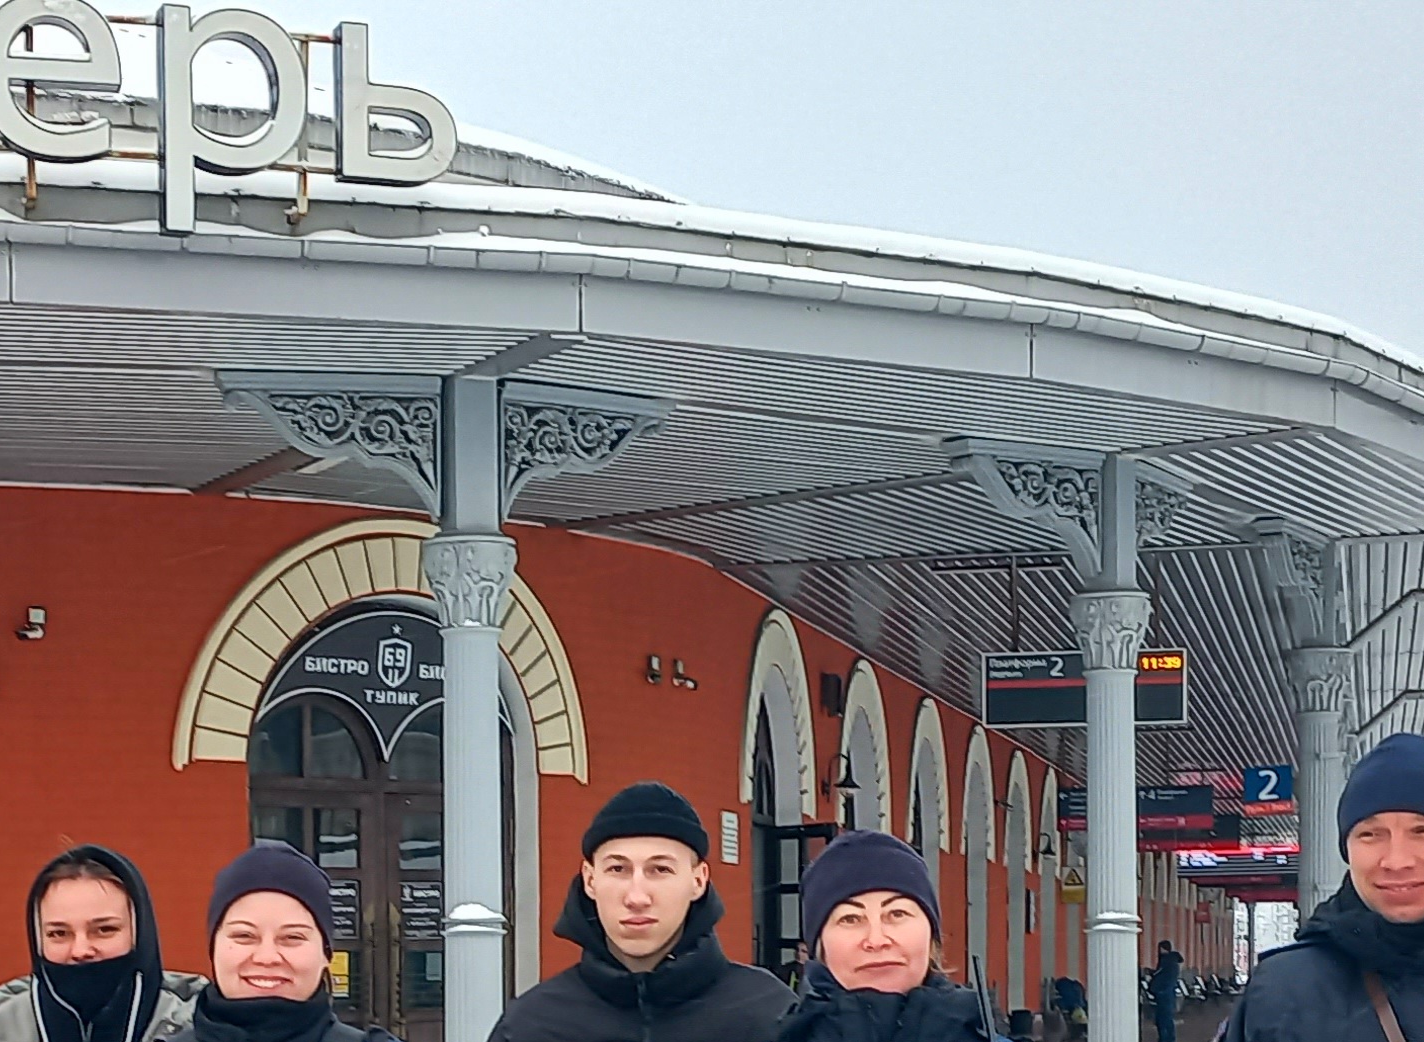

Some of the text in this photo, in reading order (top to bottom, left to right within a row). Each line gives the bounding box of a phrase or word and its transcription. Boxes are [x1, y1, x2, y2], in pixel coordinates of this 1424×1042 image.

[304, 656, 370, 675] БИСТРО
[1049, 656, 1064, 677] 2
[363, 689, 421, 706] ТУПИК
[1258, 769, 1280, 800] 2
